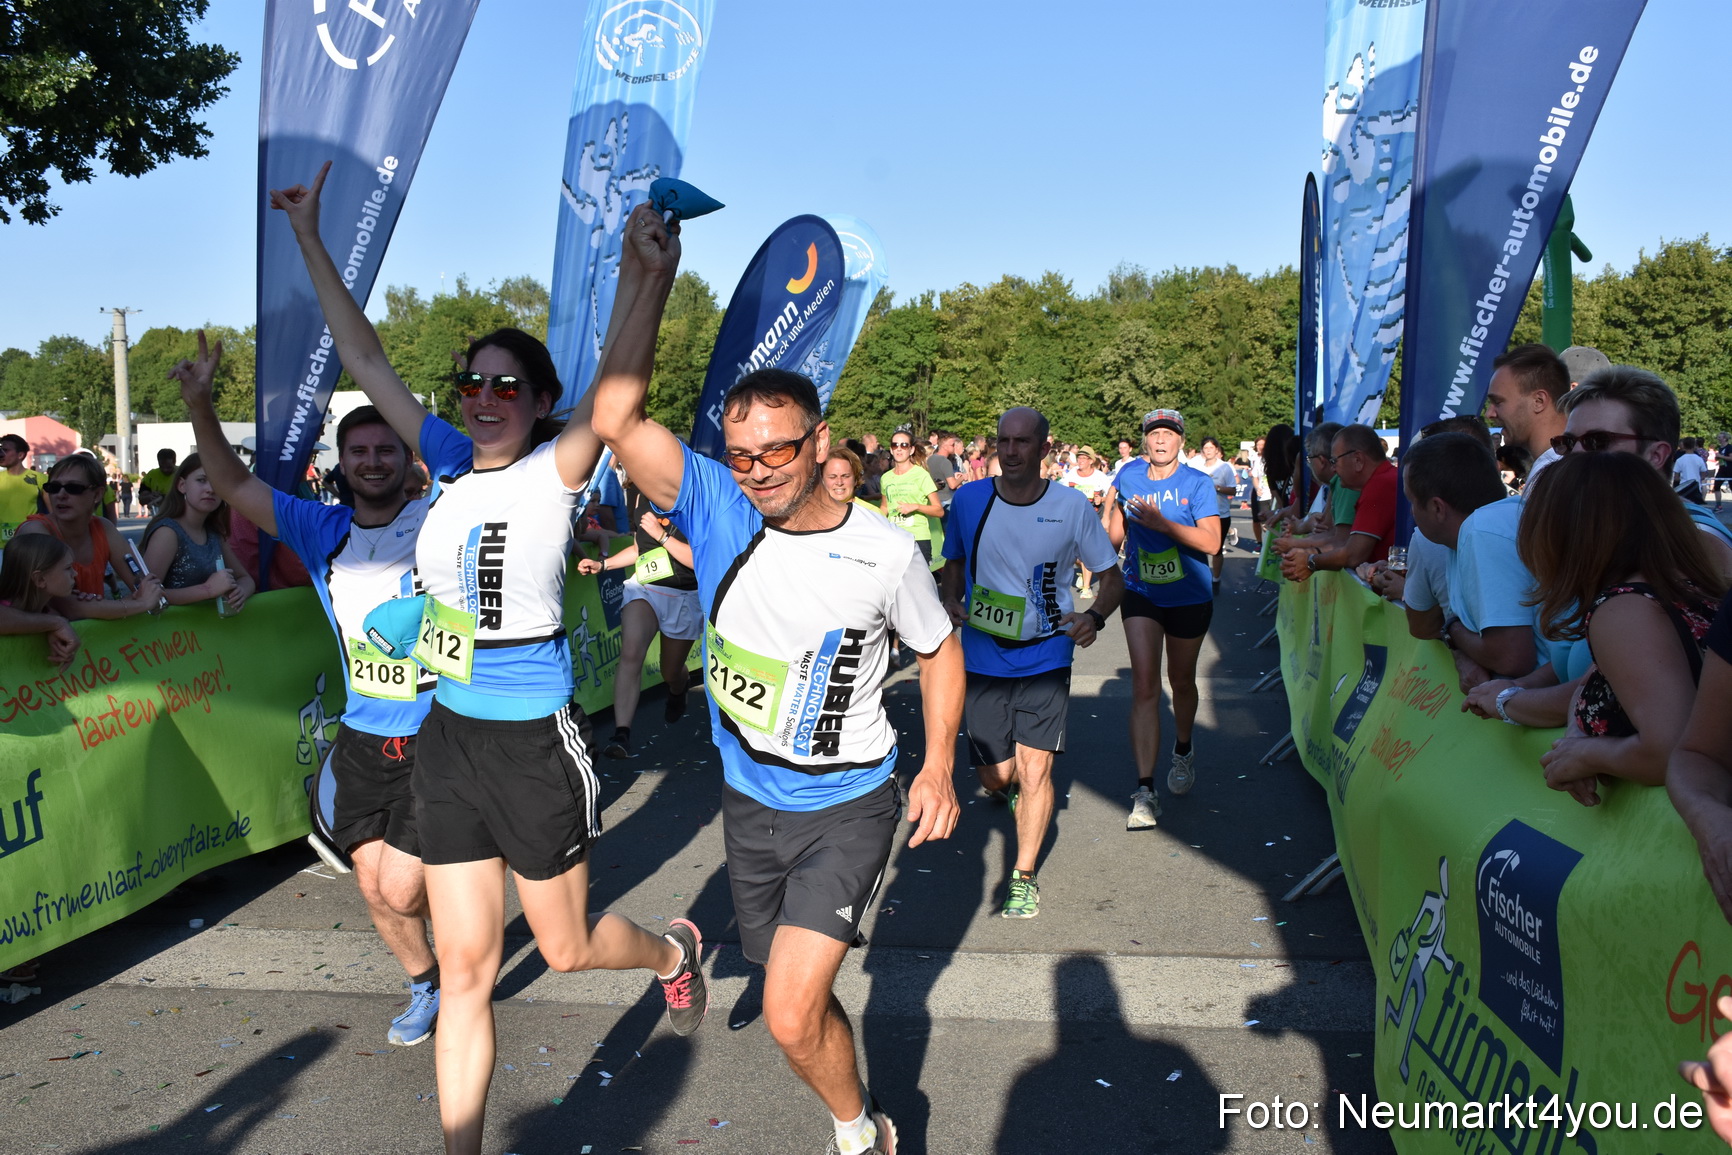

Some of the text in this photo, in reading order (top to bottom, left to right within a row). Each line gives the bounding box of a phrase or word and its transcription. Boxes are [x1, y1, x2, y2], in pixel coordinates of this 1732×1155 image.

[614, 47, 699, 84] WECHSELSZENE
[764, 278, 836, 369] Druck und Medien
[456, 544, 464, 569] WASTE
[477, 522, 508, 631] HUBER
[1142, 560, 1176, 576] 1730
[465, 545, 478, 615] TECHNOLOG
[973, 601, 1015, 627] 2101
[118, 630, 203, 675] Firmen
[354, 658, 406, 685] 2108
[799, 650, 815, 681] WASTE
[72, 654, 232, 751] laufen länger!
[709, 653, 767, 711] 2122
[789, 682, 806, 715] WATER
[796, 654, 832, 751] TECHNOLOGY
[811, 627, 867, 757] HUBER
[1487, 876, 1543, 943] Fischer
[1494, 920, 1542, 966] AUTOMOBILE
[1518, 970, 1531, 995] das
